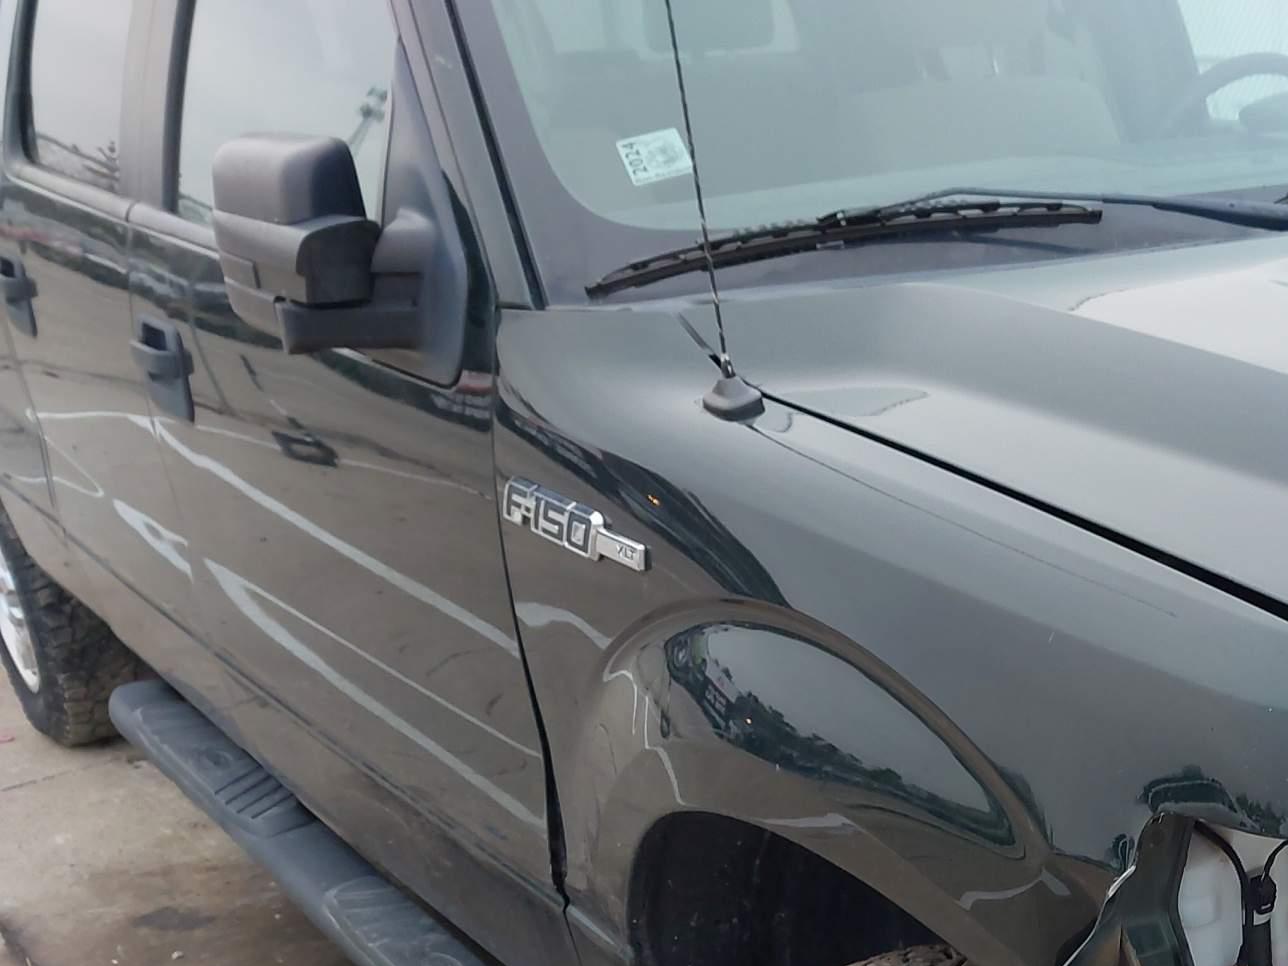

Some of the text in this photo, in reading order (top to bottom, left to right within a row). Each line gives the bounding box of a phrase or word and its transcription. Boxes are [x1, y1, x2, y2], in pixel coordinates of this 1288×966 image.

[622, 142, 648, 176] 2024
[503, 476, 636, 561] F-150 XLT
